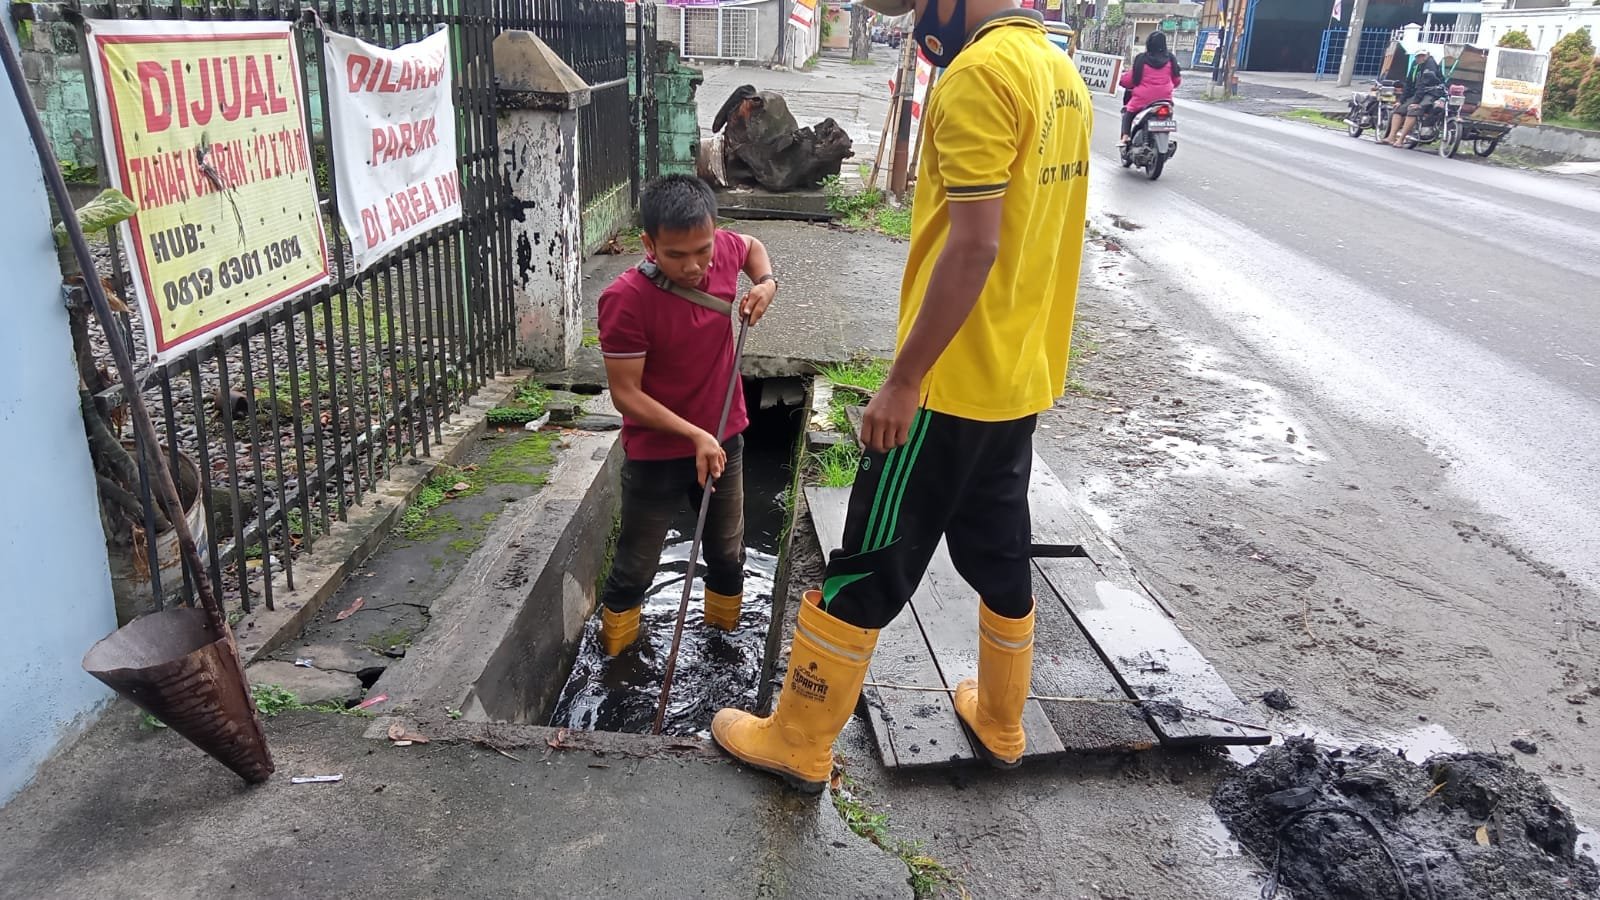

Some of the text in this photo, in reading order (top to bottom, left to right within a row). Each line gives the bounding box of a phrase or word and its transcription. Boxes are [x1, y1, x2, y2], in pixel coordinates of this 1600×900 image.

[1079, 65, 1109, 77] PELAN
[1081, 55, 1112, 66] MOHON
[137, 54, 288, 133] DIJUAL
[1083, 77, 1107, 88] ELAN
[129, 150, 190, 211] TANAH
[254, 134, 271, 180] 12
[268, 133, 281, 177] X
[279, 130, 296, 174] 78
[361, 204, 387, 248] DI
[385, 182, 438, 236] AREA
[149, 223, 205, 264] HUB:
